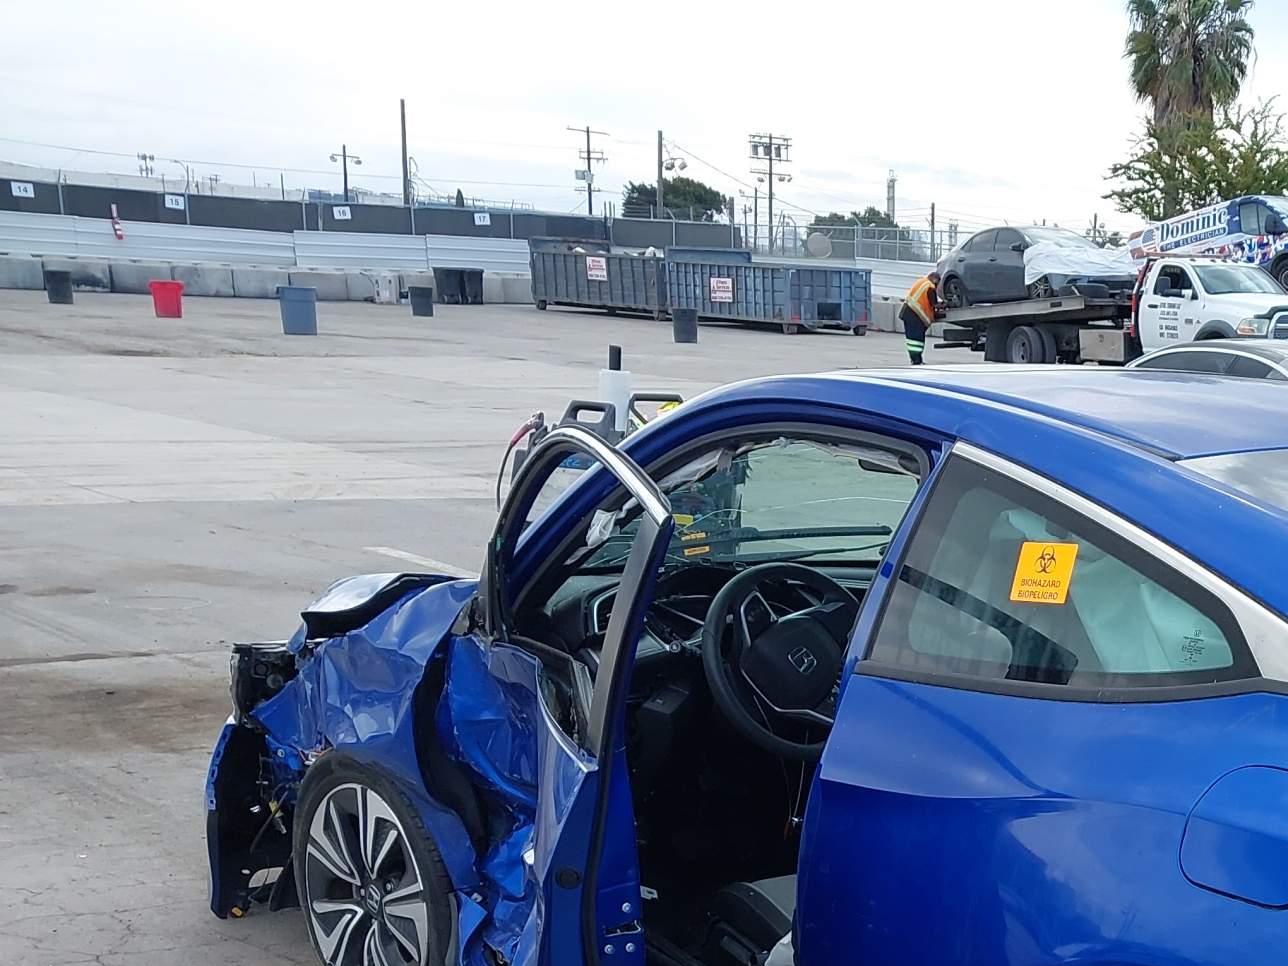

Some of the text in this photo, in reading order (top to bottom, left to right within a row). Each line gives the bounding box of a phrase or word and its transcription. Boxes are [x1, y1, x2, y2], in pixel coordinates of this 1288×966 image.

[1160, 208, 1228, 241] Dominic
[1162, 227, 1225, 251] THE ELECTRICIAN
[1020, 578, 1061, 588] BIOHAZARD
[1017, 589, 1059, 600] BIOPELIGRO
